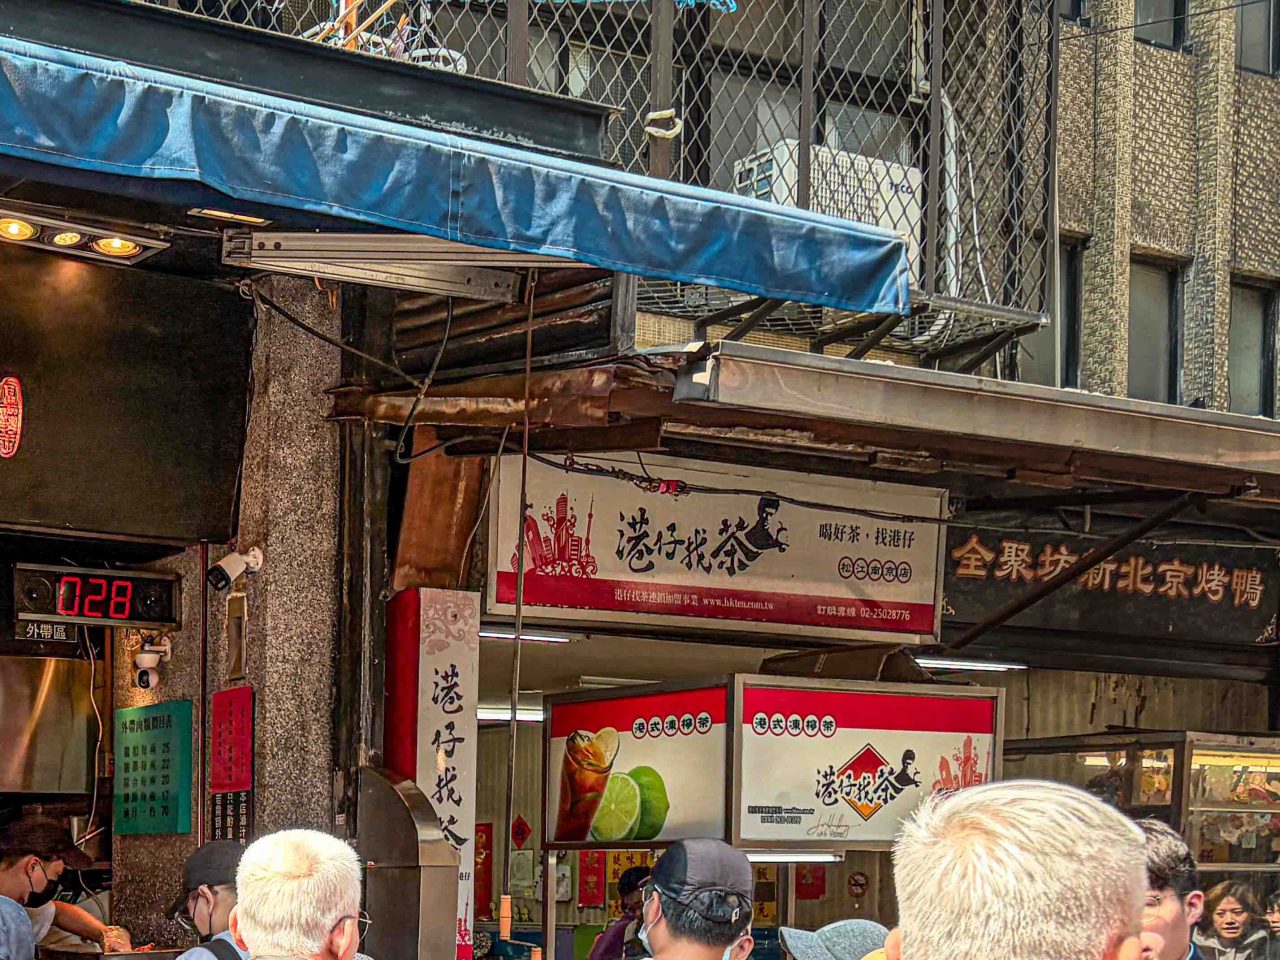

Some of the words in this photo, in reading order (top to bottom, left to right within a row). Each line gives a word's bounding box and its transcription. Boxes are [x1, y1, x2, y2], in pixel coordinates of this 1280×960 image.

[615, 505, 763, 577] 港仔找茶
[819, 522, 916, 550] 喝好茶，找港仔
[840, 560, 910, 580] 松江南京店
[58, 576, 132, 619] 028
[860, 607, 911, 620] 02-25028776
[26, 623, 67, 641] 外帶區
[634, 714, 710, 735] 港式凍檸茶
[753, 714, 835, 734] 港式凍檸茶
[814, 764, 906, 807] 港仔找茶
